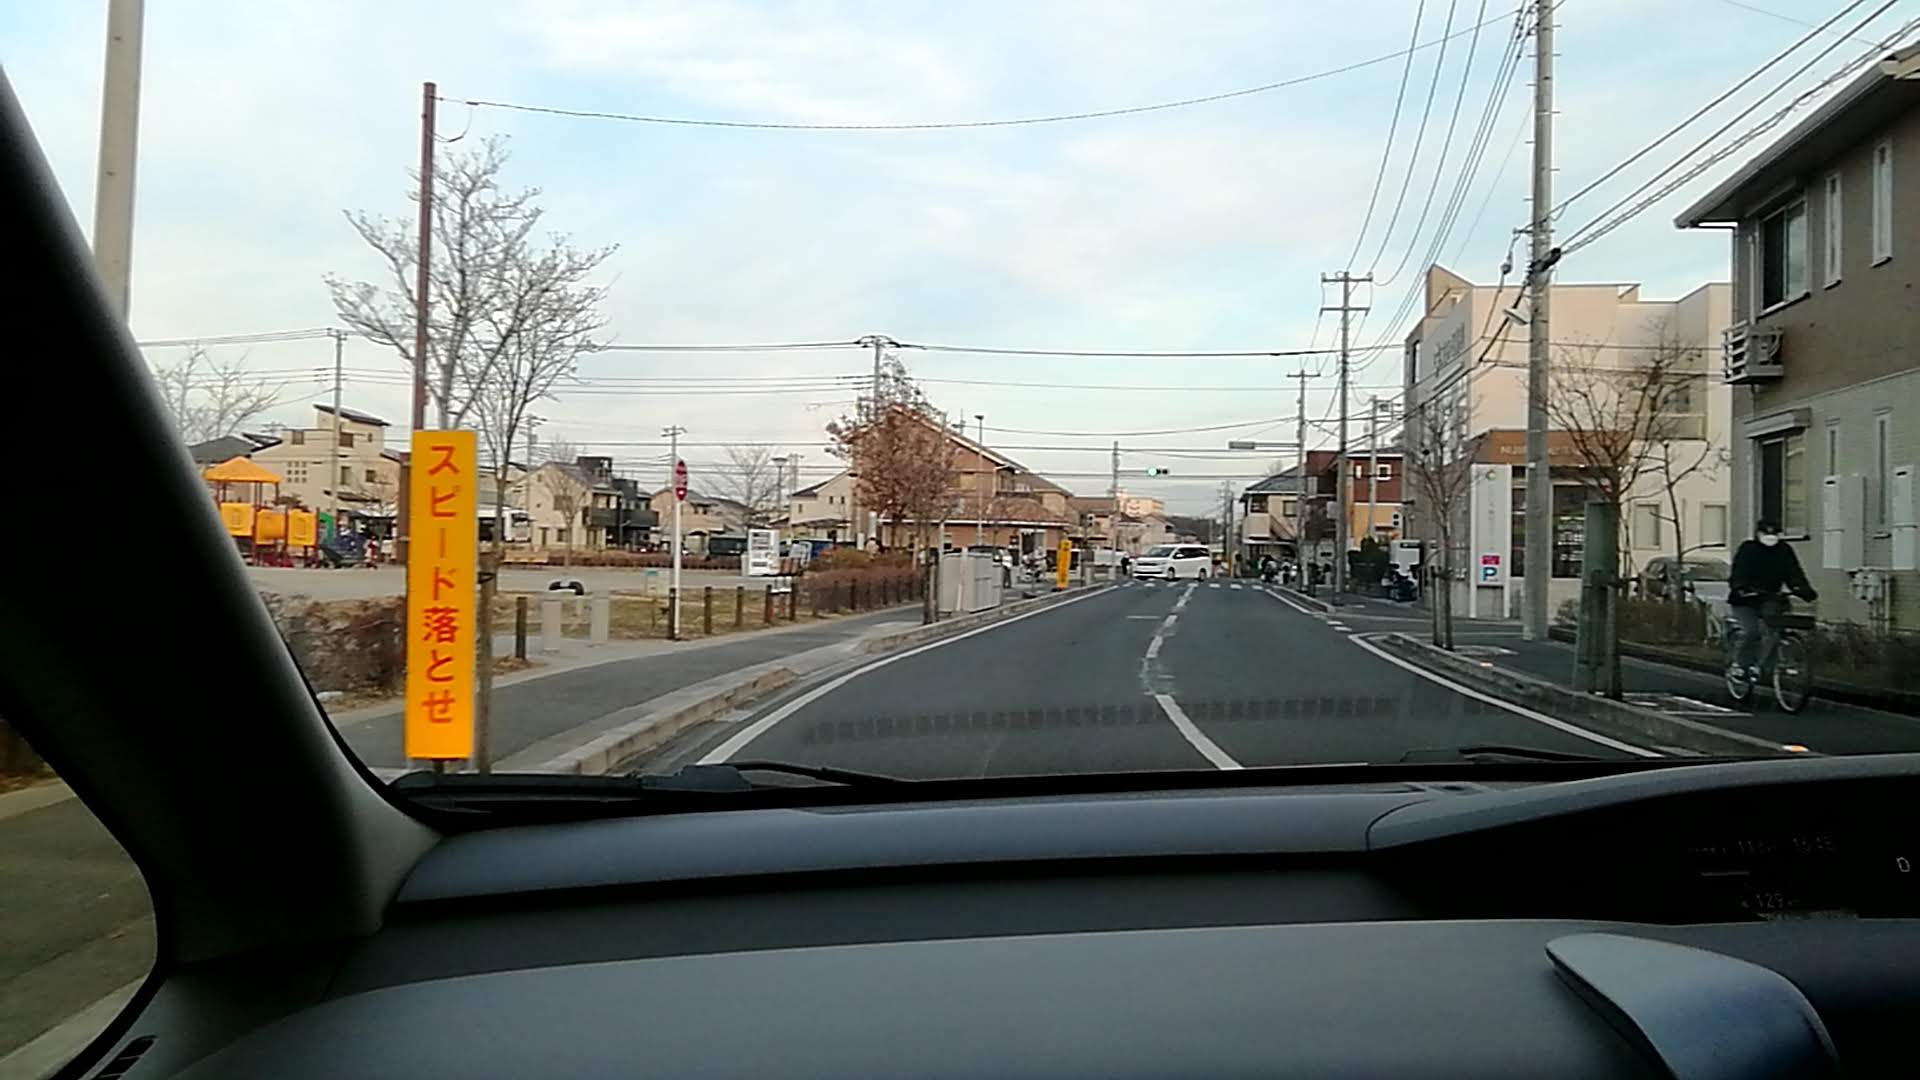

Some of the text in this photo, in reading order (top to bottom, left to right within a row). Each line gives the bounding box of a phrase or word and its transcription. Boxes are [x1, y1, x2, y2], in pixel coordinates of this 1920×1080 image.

[421, 444, 461, 724] スピード落とせ
[1482, 566, 1498, 583] P
